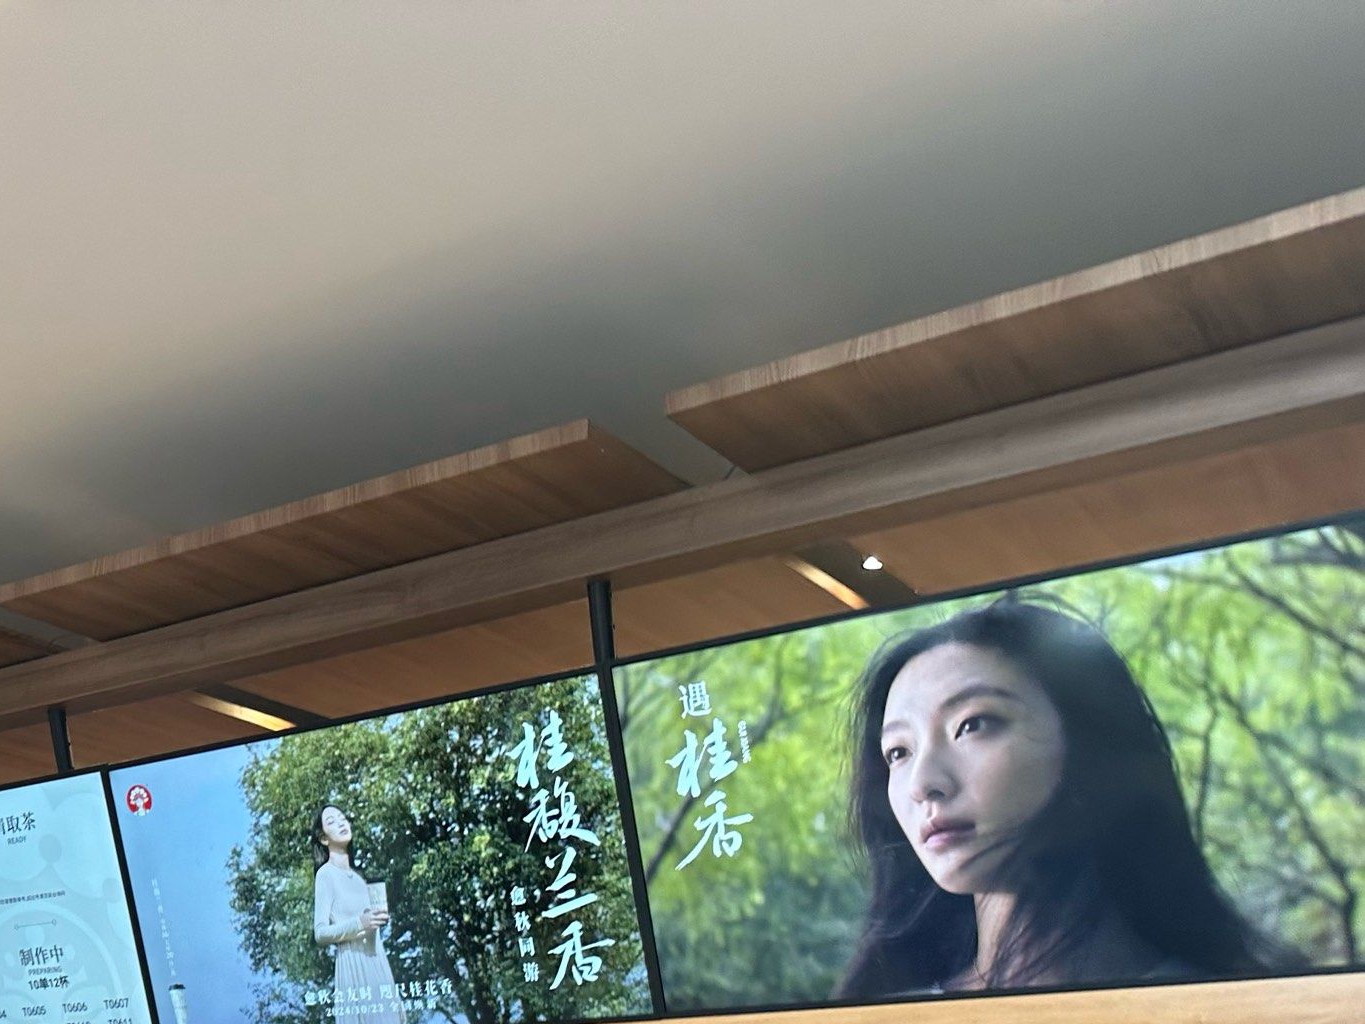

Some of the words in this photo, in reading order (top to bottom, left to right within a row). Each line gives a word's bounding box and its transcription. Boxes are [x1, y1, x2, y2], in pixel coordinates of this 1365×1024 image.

[7, 836, 27, 846] READY
[506, 709, 616, 990] 桂馥兰香
[19, 945, 63, 966] 制作中
[62, 1001, 88, 1013] T0606
[103, 997, 130, 1010] T0607
